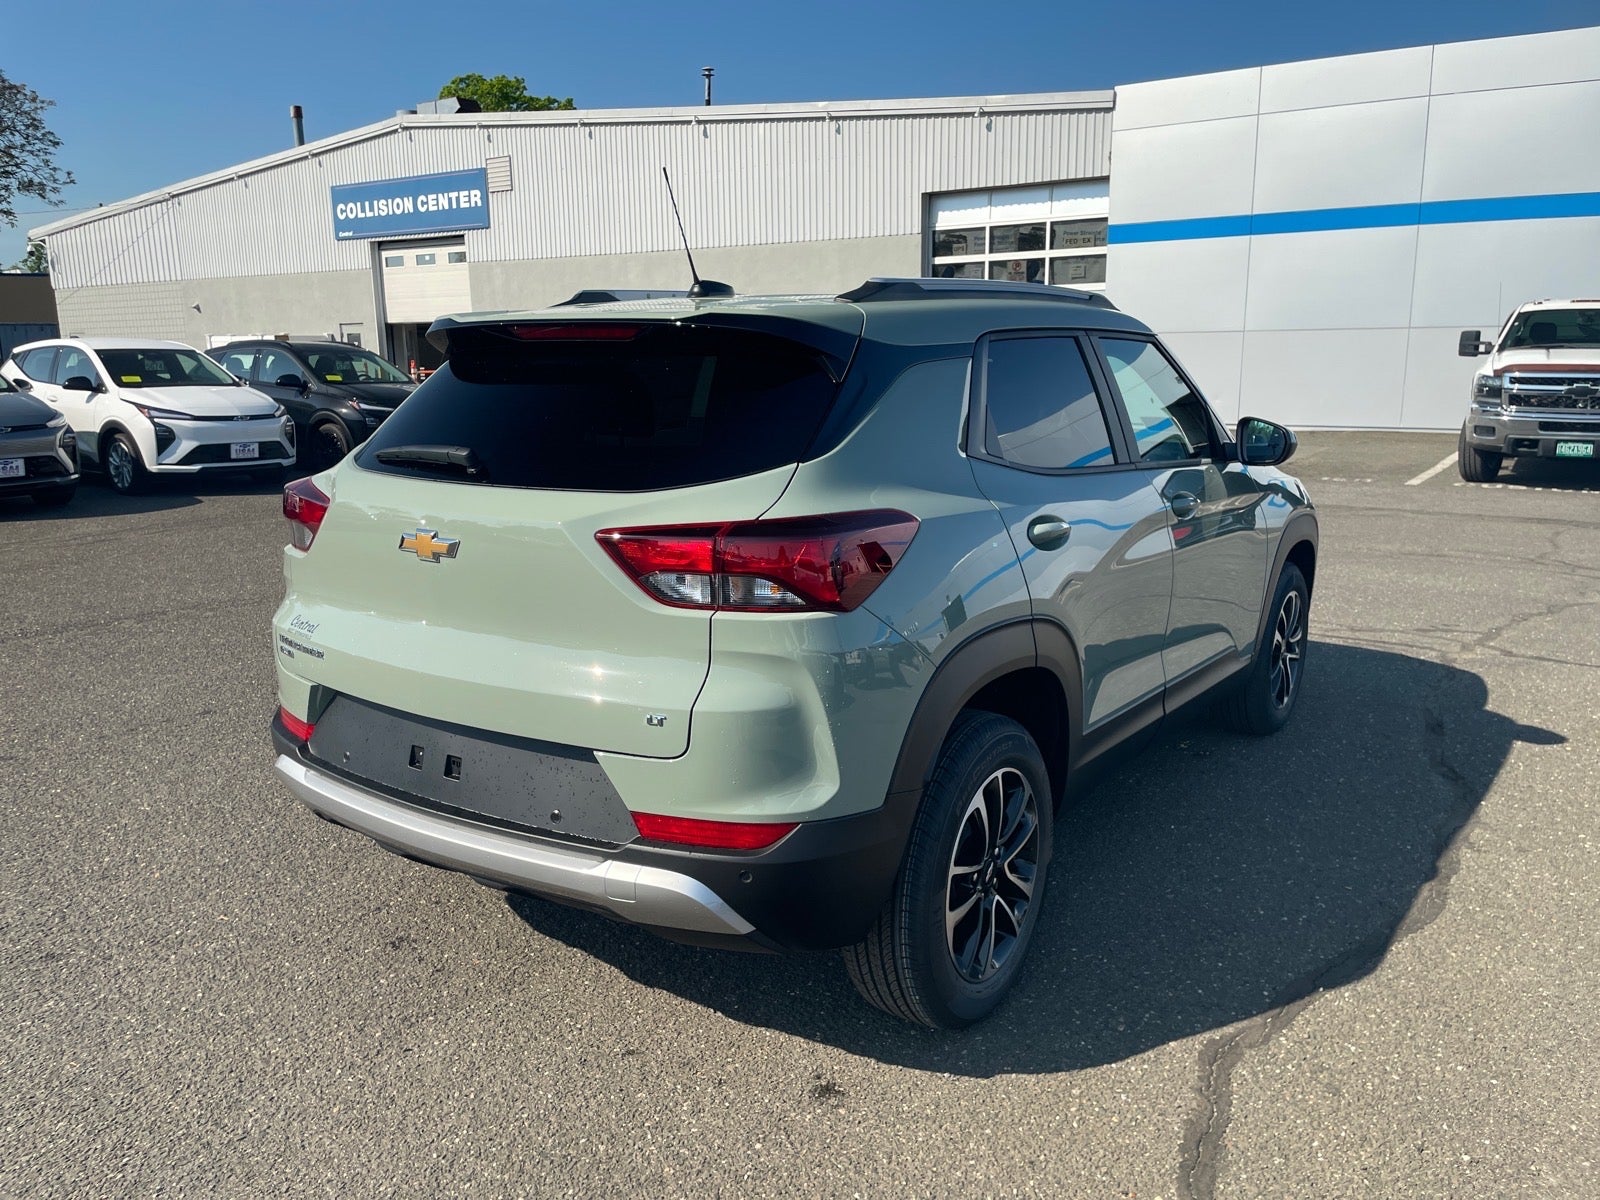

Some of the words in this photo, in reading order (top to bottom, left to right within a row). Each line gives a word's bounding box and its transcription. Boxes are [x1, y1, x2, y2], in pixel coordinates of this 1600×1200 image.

[336, 196, 414, 220] COLLISION
[417, 189, 482, 213] CENTER
[290, 614, 321, 634] Central
[646, 713, 668, 728] LT
